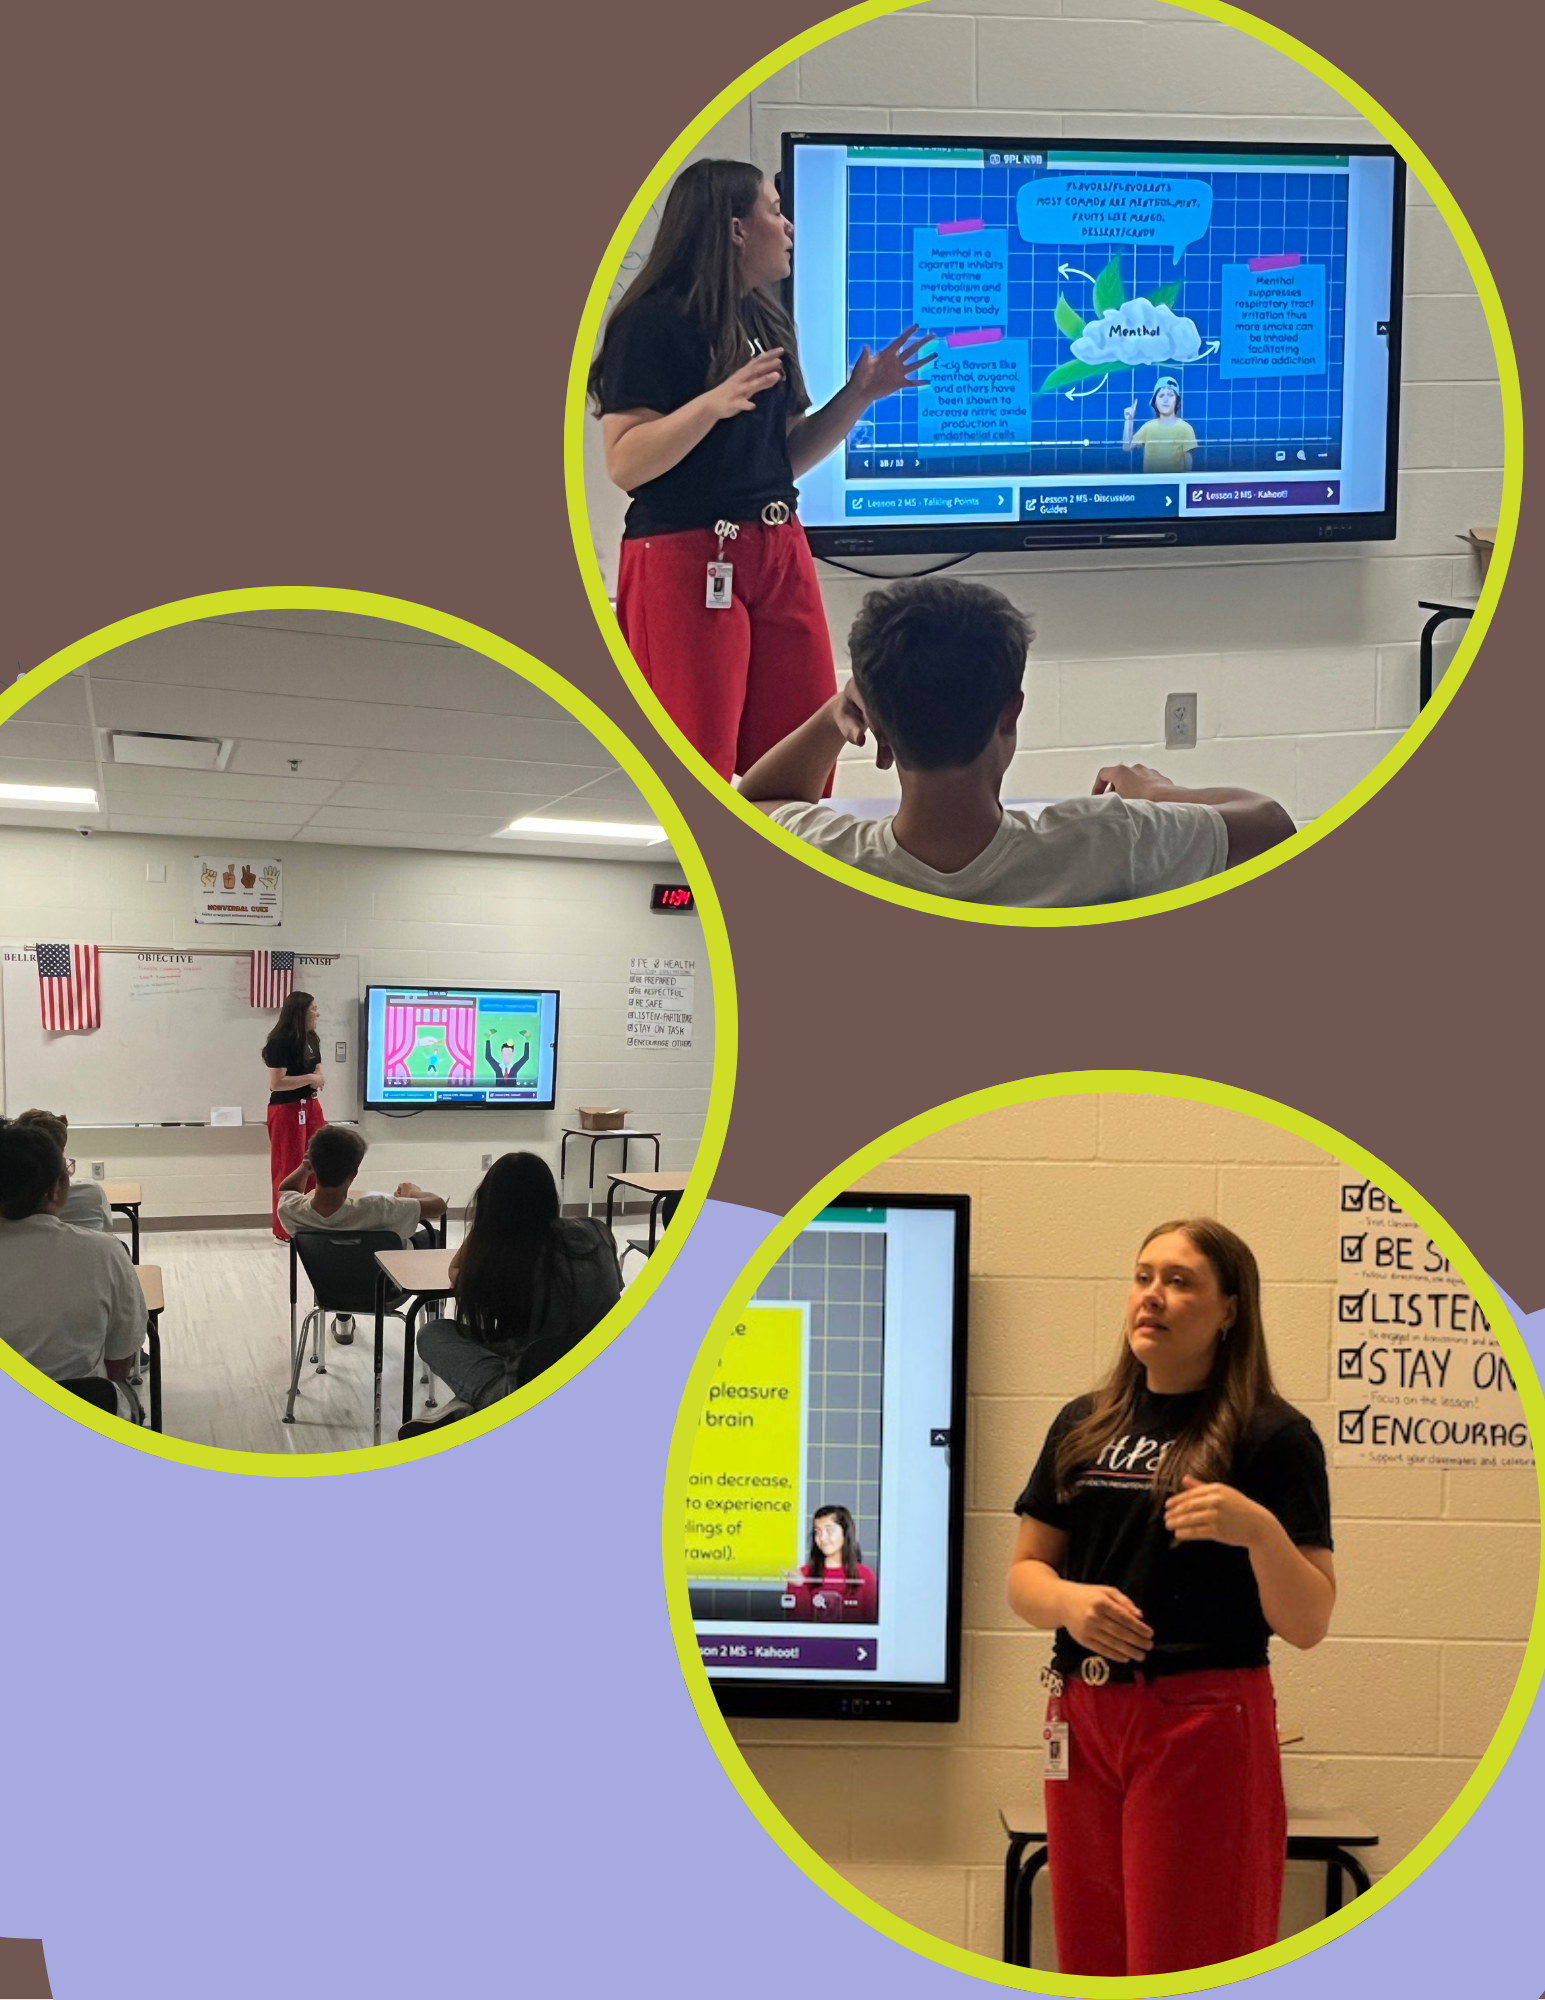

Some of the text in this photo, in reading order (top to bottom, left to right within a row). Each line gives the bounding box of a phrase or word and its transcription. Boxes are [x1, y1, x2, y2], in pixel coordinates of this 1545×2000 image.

[1003, 154, 1021, 164] 9PL
[931, 248, 991, 258] Menthol in a
[918, 260, 1003, 271] cigarette inhibits
[941, 271, 981, 280] nicotine
[1256, 275, 1294, 285] Menthol
[920, 282, 1001, 292] metabolism and
[931, 294, 990, 303] hence more
[1248, 289, 1302, 299] suppresses
[921, 304, 999, 316] nicotine in body
[1235, 300, 1314, 310] respiratory tract
[1241, 310, 1307, 319] irritation thus
[1109, 325, 1160, 337] Menthol
[1235, 323, 1260, 331] more
[1262, 321, 1293, 331] smoke
[1249, 332, 1298, 342] be inhaled
[1248, 344, 1300, 356] facilitating
[962, 360, 997, 369] flavors
[999, 359, 1016, 369] like
[1231, 355, 1315, 365] nicotine addiction
[934, 382, 1015, 393] and others have
[938, 396, 1012, 405] been shown to
[922, 406, 1027, 417] decrease nitric oxide
[941, 419, 1008, 430] production in
[933, 430, 1015, 440] endothelial cells
[1040, 495, 1068, 504] Lesson
[1094, 493, 1135, 503] Discussion
[1206, 491, 1233, 500] Lesson
[867, 498, 895, 508] Lesson
[924, 498, 952, 508] Talking
[954, 497, 979, 506] Points
[1040, 505, 1067, 514] Guides
[137, 953, 194, 963] OBJECTIVE
[299, 957, 331, 966] FINISH
[664, 960, 695, 969] HEALTH
[635, 976, 676, 985] BE PREPARED
[644, 988, 684, 998] RESPECTFUL
[635, 999, 663, 1008] BE SAFE
[634, 1024, 685, 1035] STAY ON TASK
[633, 1038, 669, 1047] ENCOURAGE
[1375, 1237, 1414, 1270] BE
[1372, 1293, 1491, 1332] LISTEN
[1368, 1348, 1518, 1391] STAY ON
[709, 1382, 789, 1401] pleasure
[1371, 1391, 1479, 1409] Focus on the lesson!
[705, 1410, 754, 1427] brain
[1372, 1415, 1534, 1450] ENCOURAG
[1368, 1451, 1404, 1464] Support
[1406, 1453, 1427, 1466] your
[1428, 1454, 1477, 1466] classmates
[717, 1472, 792, 1489] decrease,
[685, 1498, 792, 1513] to experience
[726, 1522, 743, 1536] of
[719, 1645, 728, 1657] 2
[729, 1645, 747, 1657] MS
[754, 1646, 800, 1659] Kahoot!
